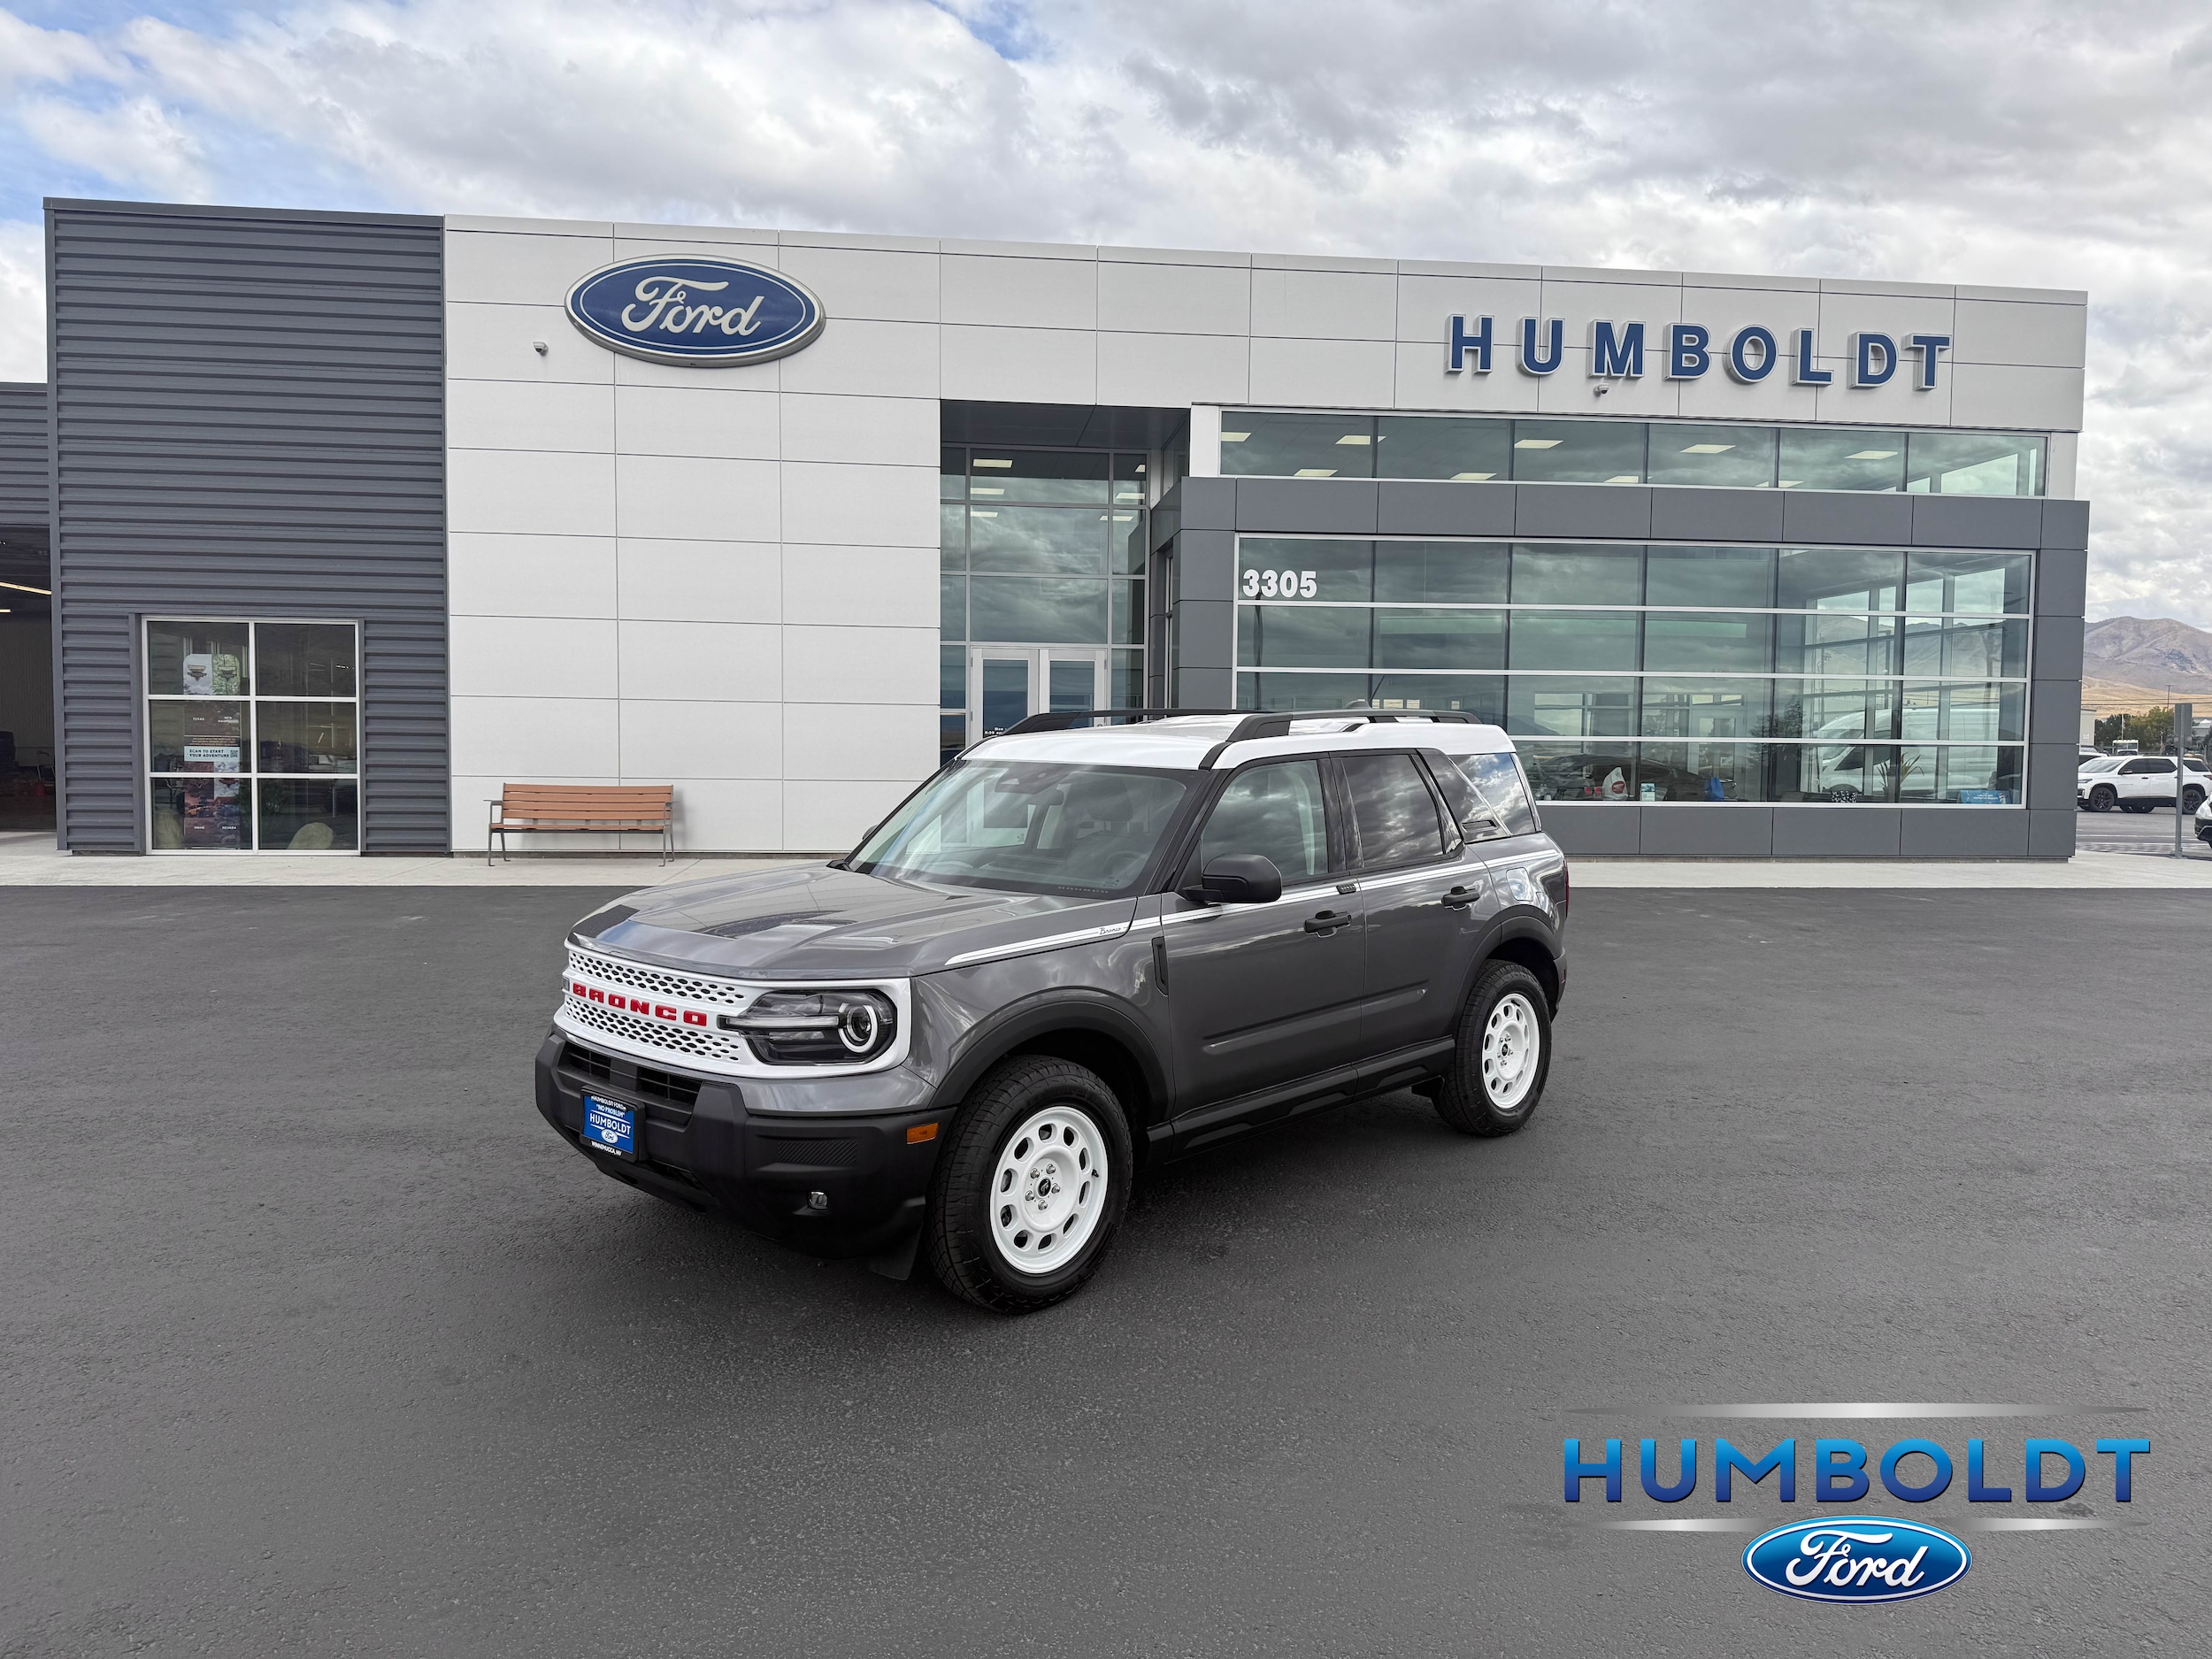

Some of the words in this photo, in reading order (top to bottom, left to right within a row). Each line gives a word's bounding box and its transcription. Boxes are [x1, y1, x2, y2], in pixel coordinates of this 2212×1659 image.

[621, 275, 764, 336] Ford
[1446, 314, 1952, 390] HUMBOLDT
[1242, 569, 1317, 598] 3305
[572, 982, 708, 1026] BRONCO
[590, 1113, 631, 1134] HUMBOLDT
